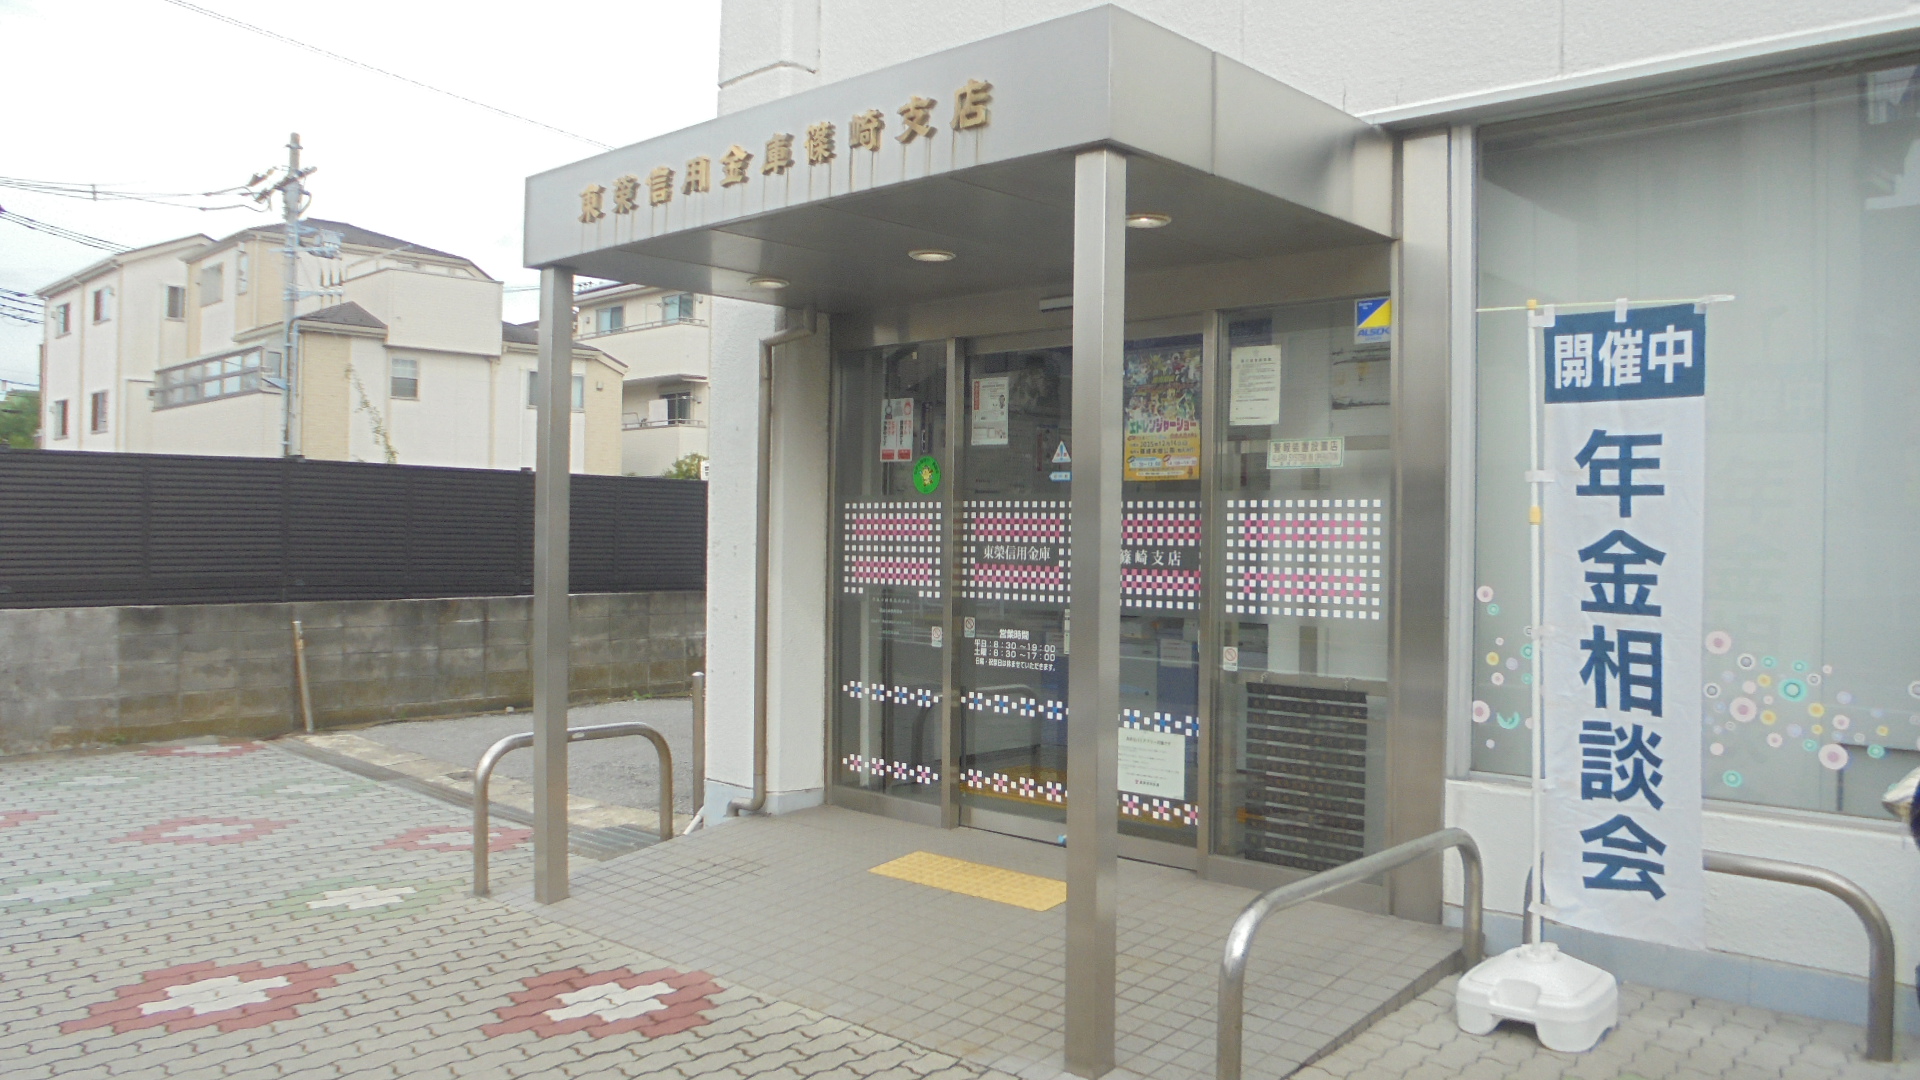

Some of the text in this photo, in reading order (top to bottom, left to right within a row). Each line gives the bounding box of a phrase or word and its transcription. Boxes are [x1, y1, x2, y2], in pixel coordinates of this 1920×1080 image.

[1553, 324, 1696, 390] 開催中
[983, 544, 1051, 562] 東榮信用金庫
[1120, 548, 1182, 567] 篠崎支店
[999, 628, 1030, 641] 営業時間
[1574, 428, 1667, 901] 年金相談会
